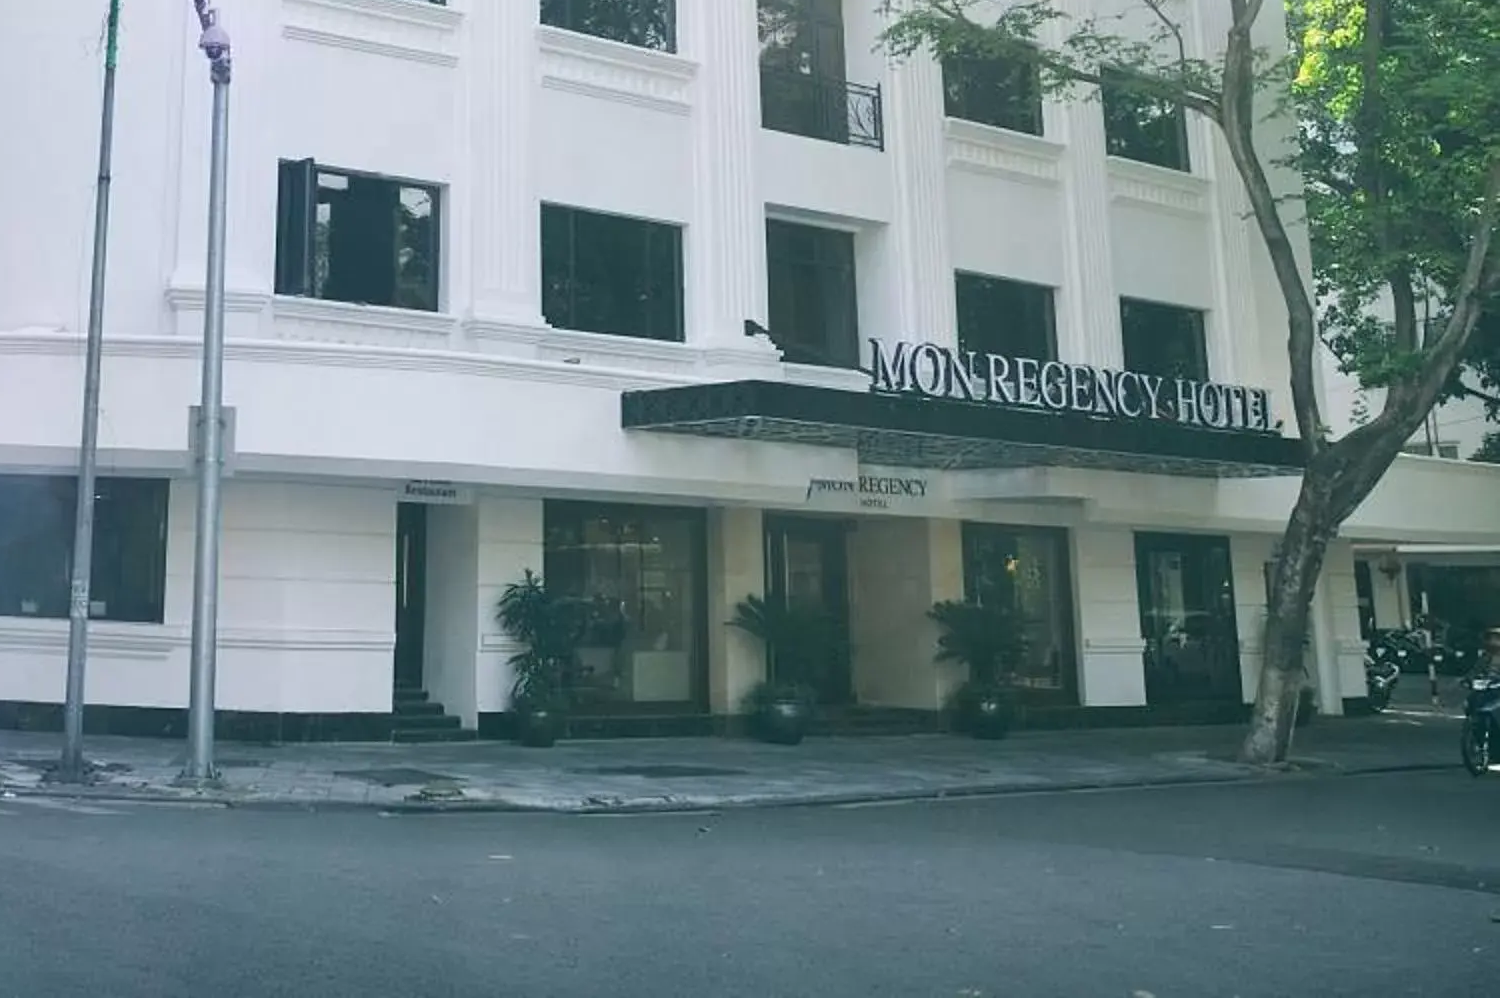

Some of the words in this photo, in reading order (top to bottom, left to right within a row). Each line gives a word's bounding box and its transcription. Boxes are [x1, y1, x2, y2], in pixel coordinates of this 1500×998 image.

[868, 338, 977, 400] MON
[985, 352, 1163, 420] REGENCY
[1171, 377, 1283, 433] HOTEL
[857, 475, 928, 498] REGENCY
